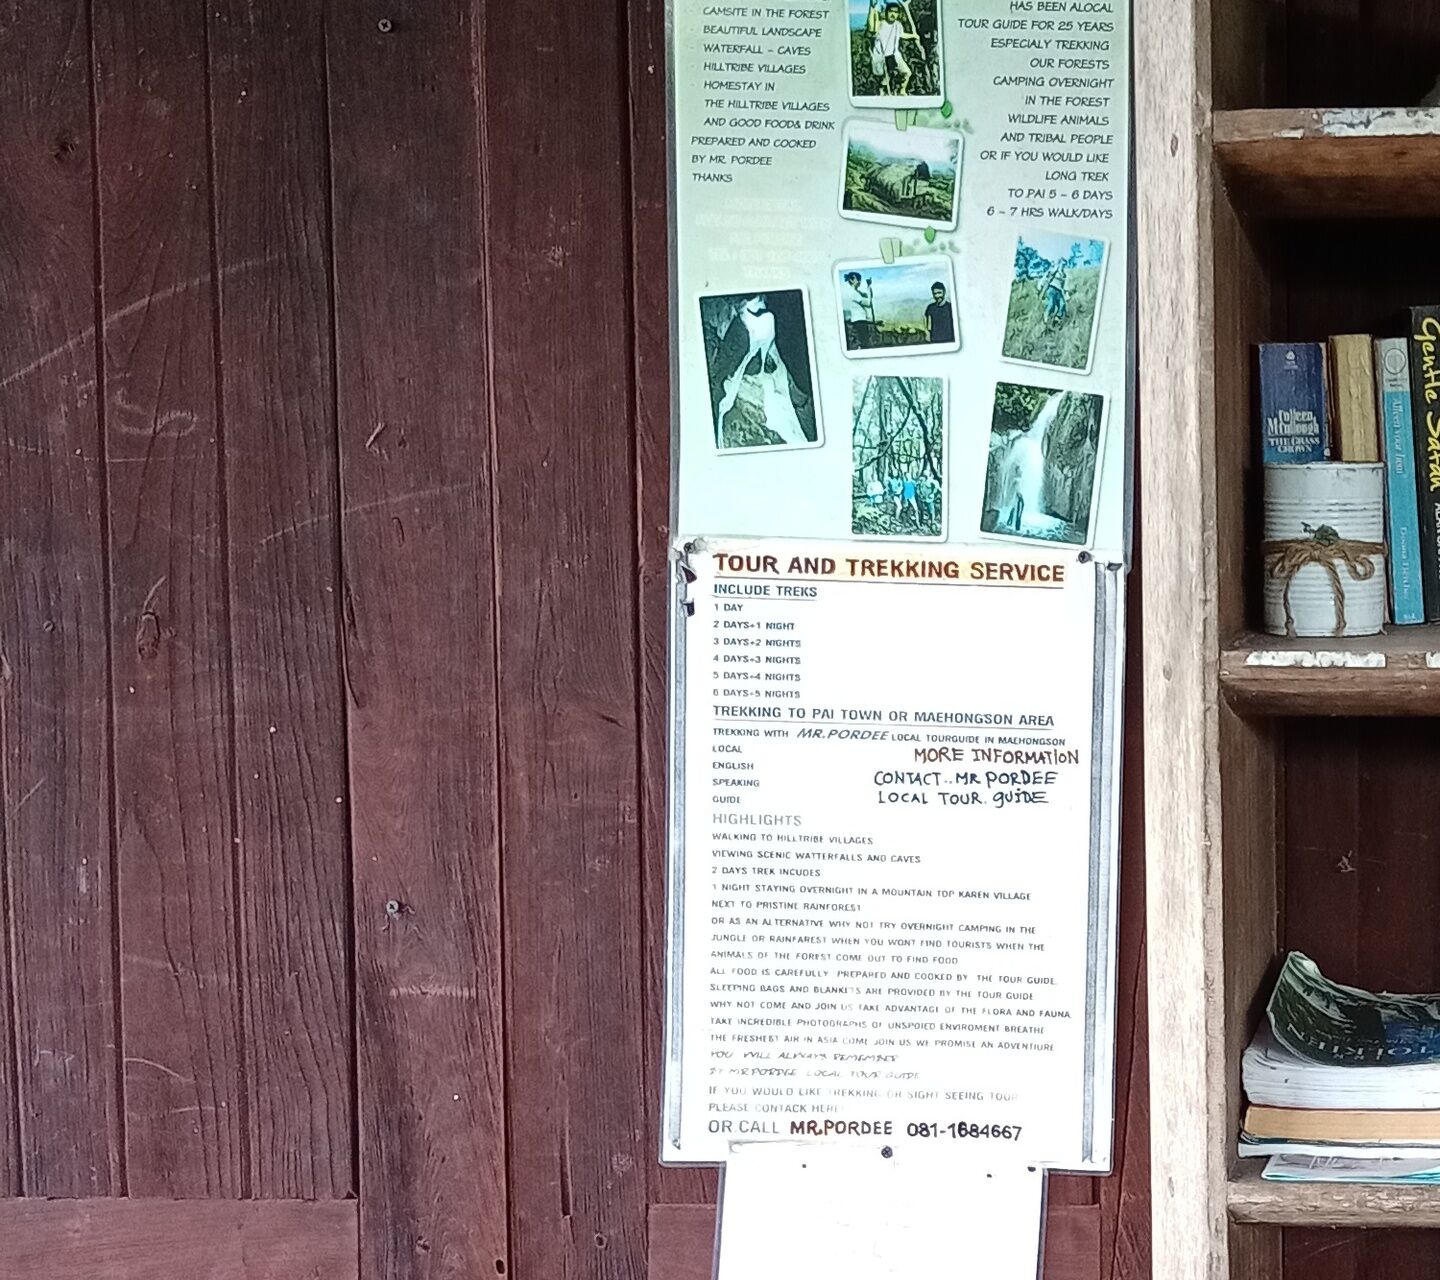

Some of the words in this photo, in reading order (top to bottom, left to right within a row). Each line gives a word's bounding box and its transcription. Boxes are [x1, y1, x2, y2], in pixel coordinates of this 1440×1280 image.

[703, 7, 748, 17] CAMSITE
[751, 8, 762, 17] IN
[763, 7, 786, 18] THE
[788, 9, 830, 20] FOREST
[1010, 1, 1033, 11] HAS
[1037, 1, 1067, 12] BEEN
[703, 25, 759, 36] BEAUTIFUL
[761, 26, 822, 38] LANDSCAPE
[958, 19, 988, 28] TOUR
[992, 18, 1028, 30] GUIDE
[1031, 20, 1055, 31] FOR
[1057, 20, 1074, 31] 25
[1075, 21, 1114, 32] YEARS
[990, 37, 1053, 50] ESPECIALY
[1054, 39, 1110, 52] TREKKING
[703, 59, 755, 73] HILLTRIBE
[757, 63, 806, 75] VILLAGES
[1030, 58, 1054, 68] OUR
[1057, 57, 1110, 73] FORESTS
[703, 80, 763, 91] HOMESTAY
[764, 81, 775, 92] IN
[992, 75, 1045, 87] CAMPING
[1048, 76, 1115, 89] OVERNIGHT
[704, 97, 725, 109] THE
[727, 99, 779, 110] HILLTRIBE
[781, 99, 830, 112] VILLAGES
[1025, 95, 1039, 105] IN
[1039, 95, 1063, 106] THE
[1065, 96, 1111, 108] FOREST
[703, 117, 726, 127] AND
[728, 117, 762, 128] GOOD
[804, 120, 835, 130] DRINK
[1008, 113, 1058, 125] WILDLIFE
[1060, 112, 1110, 126] ANIMALS
[691, 135, 746, 147] PREPARED
[747, 136, 771, 148] AND
[773, 138, 817, 149] COOKED
[1000, 132, 1025, 143] AND
[1028, 132, 1067, 144] TRIBAL
[1070, 133, 1114, 145] PEOPLE
[980, 150, 997, 161] OR
[1000, 150, 1012, 161] IF
[1014, 150, 1039, 162] YOU
[1042, 151, 1083, 163] WOULD
[1086, 153, 1109, 164] LIKE
[692, 172, 733, 183] THANKS
[1045, 170, 1077, 181] LONG
[1080, 171, 1109, 182] TREK
[1291, 437, 1320, 445] GRASS
[712, 552, 780, 575] TOUR
[787, 556, 836, 575] AND
[845, 558, 959, 579] TREKKING
[970, 562, 1065, 582] SERVICE
[714, 584, 771, 596] INCLUDE
[776, 585, 818, 598] TREKS
[723, 603, 744, 612] DAY
[713, 705, 781, 718] TREKKING
[788, 707, 806, 719] TO
[812, 708, 834, 719] PAI
[840, 709, 882, 721] TOWN
[889, 711, 908, 722] OR
[914, 711, 1013, 725] MAEHONGSON
[1018, 715, 1054, 726] AREA
[713, 727, 760, 737] TREKKING
[764, 729, 789, 738] WITH
[796, 728, 889, 741] MR.PORDEE
[891, 733, 921, 741] LOCAL
[926, 734, 979, 744] TOURGUIDE
[984, 736, 994, 744] IN
[998, 736, 1066, 746] MAEHONGSON
[712, 744, 742, 754] LOCAL
[914, 746, 964, 764] MORE
[971, 747, 1079, 765] INFORMATION
[987, 771, 1058, 788] PORDEE
[879, 791, 928, 804] LOCAL
[713, 813, 802, 827] HIGHLIGHTS
[1287, 1022, 1428, 1061] TOLKIEN
[708, 1119, 733, 1134] OR
[739, 1120, 780, 1134] CALL
[790, 1119, 893, 1136] MR.PORDEE
